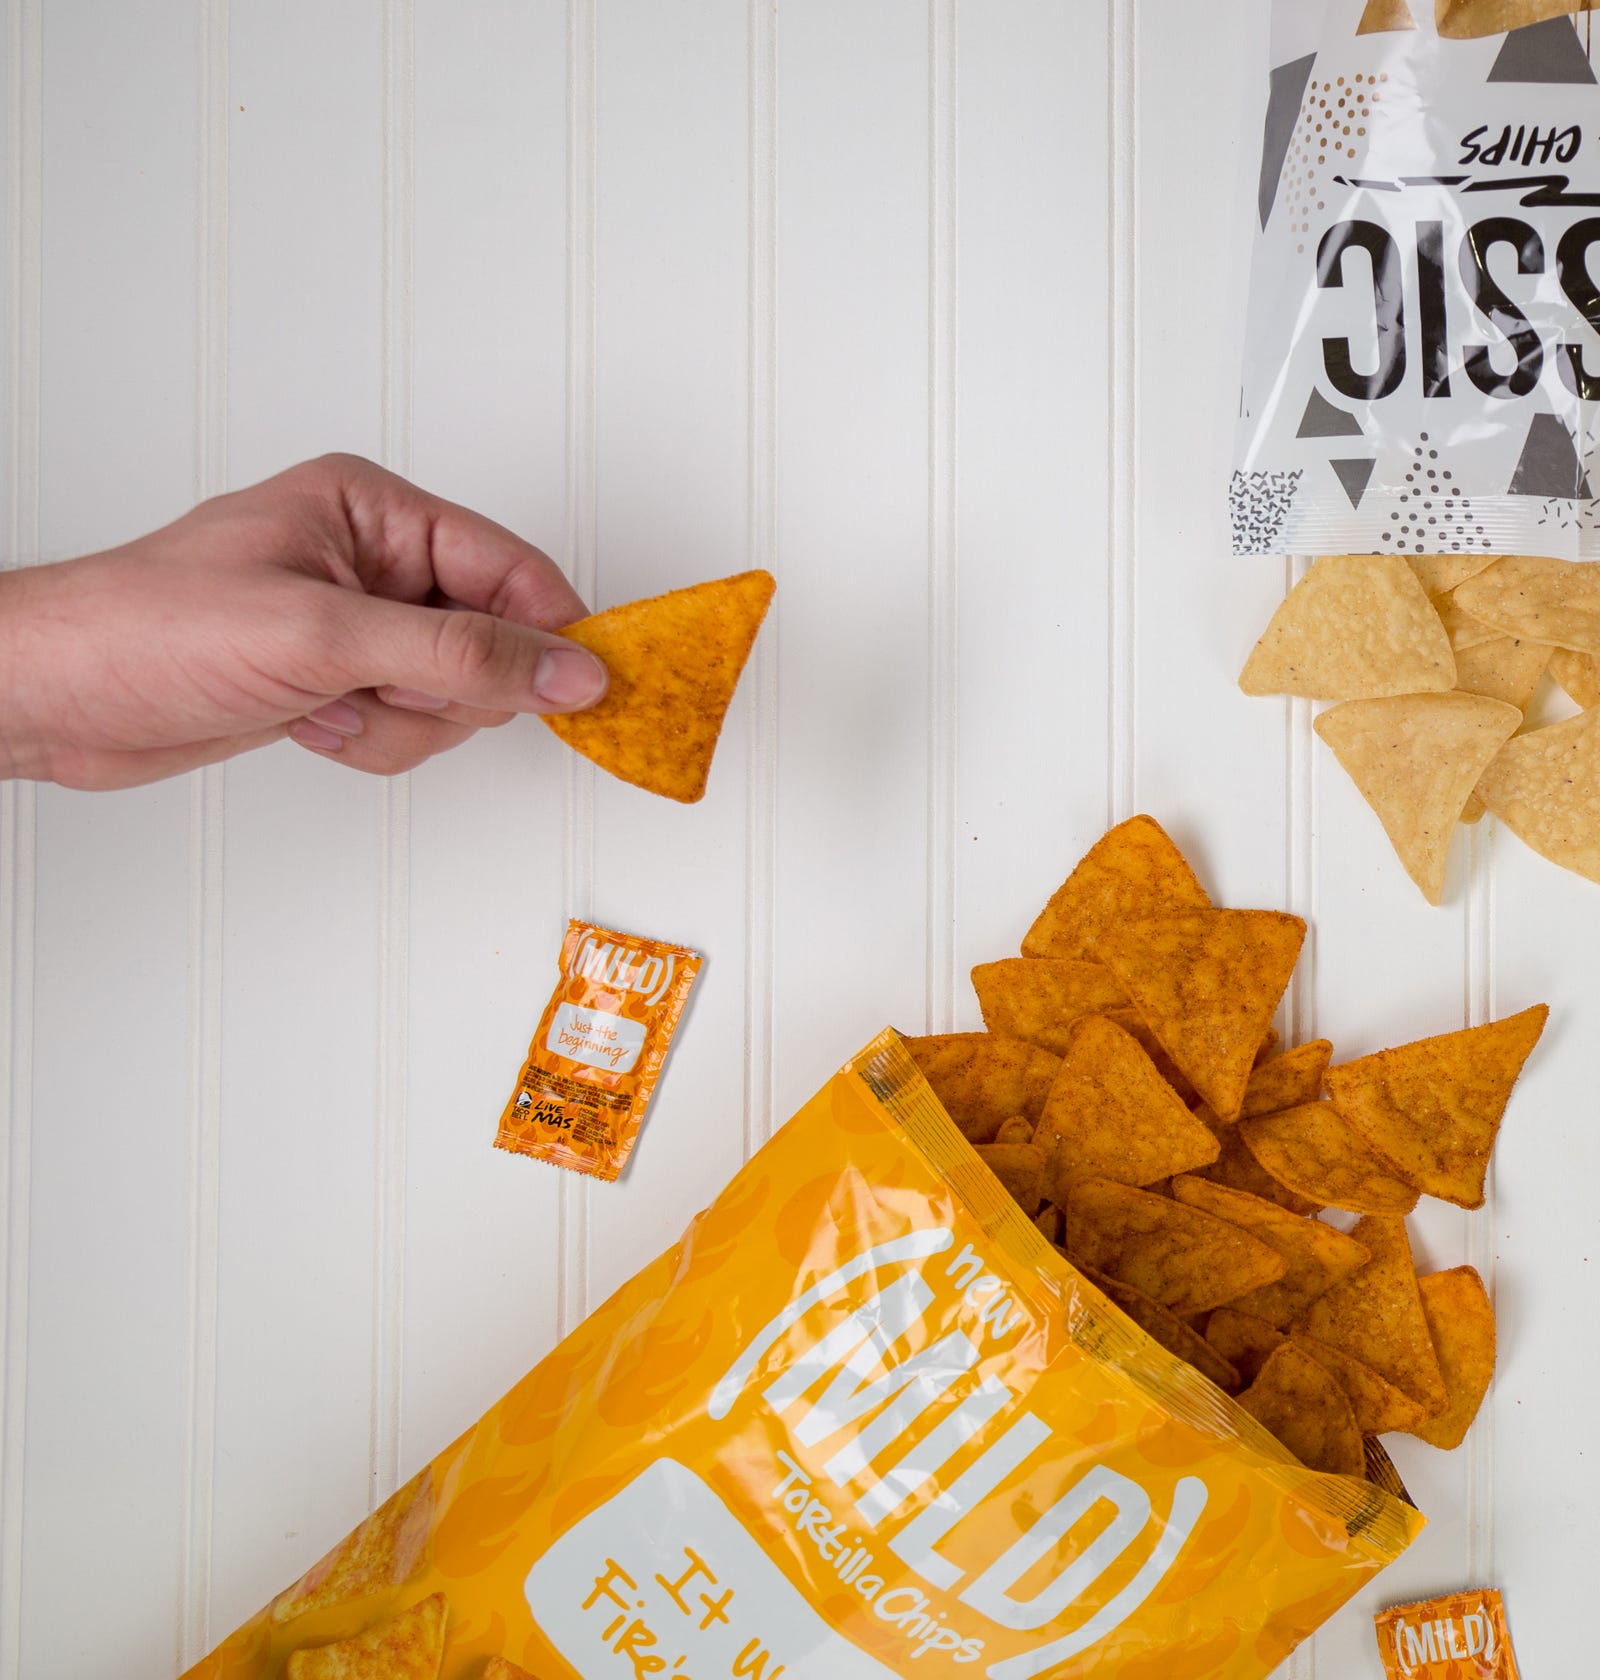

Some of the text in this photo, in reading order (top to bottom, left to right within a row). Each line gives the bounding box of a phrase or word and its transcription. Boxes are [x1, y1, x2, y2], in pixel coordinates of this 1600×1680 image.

[1459, 124, 1582, 165] CHIPS
[569, 929, 675, 1006] (MILD)
[558, 1030, 629, 1066] beginning
[569, 1014, 618, 1041] Just the
[945, 1241, 1022, 1340] new
[708, 1227, 1208, 1680] (MILD)
[654, 1546, 734, 1630] It
[873, 1587, 985, 1663] Chips
[1396, 1604, 1494, 1677] (MILD)
